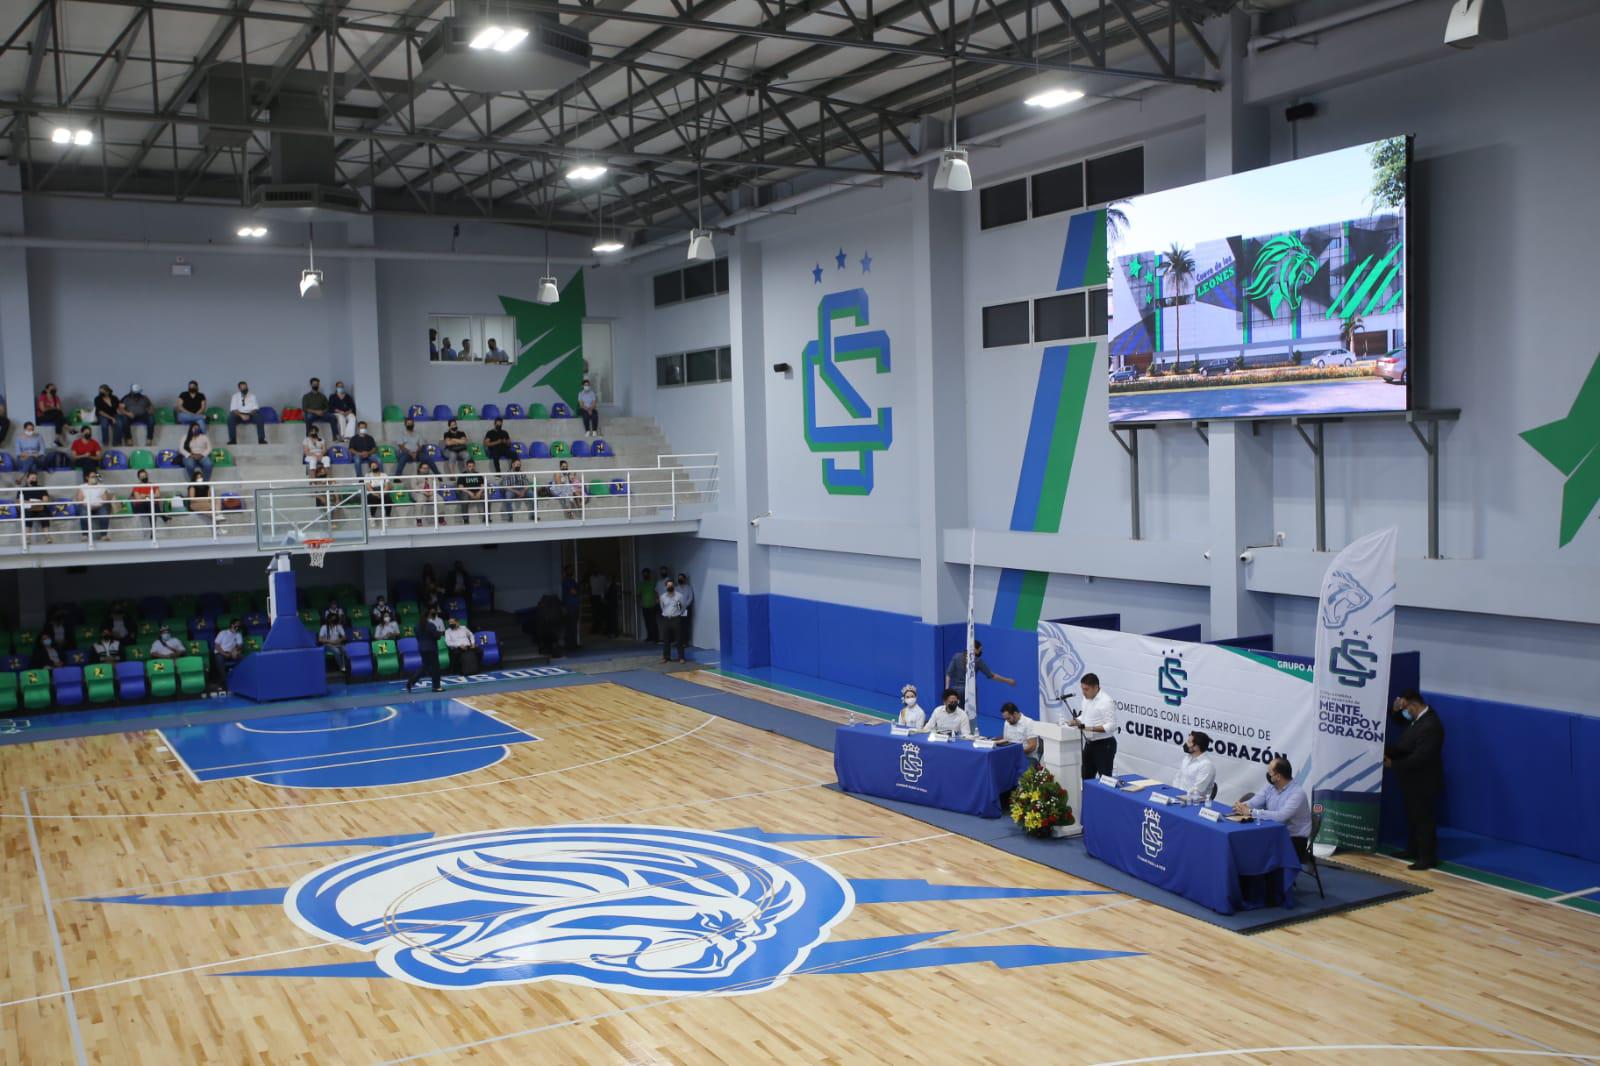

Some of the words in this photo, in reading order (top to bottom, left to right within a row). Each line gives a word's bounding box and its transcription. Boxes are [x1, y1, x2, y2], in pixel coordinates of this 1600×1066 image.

[1197, 267, 1234, 297] LEONES
[1277, 661, 1305, 672] GRUPO
[1320, 700, 1363, 718] MENTE,
[1160, 710, 1180, 723] CON
[1182, 715, 1191, 726] EL
[1194, 717, 1255, 738] DESARROLLO
[1258, 729, 1271, 741] DE
[1319, 711, 1370, 728] CUERPO
[1371, 720, 1381, 731] Y
[1125, 721, 1184, 745] CUERPO
[1319, 722, 1384, 742] CORAZÓN
